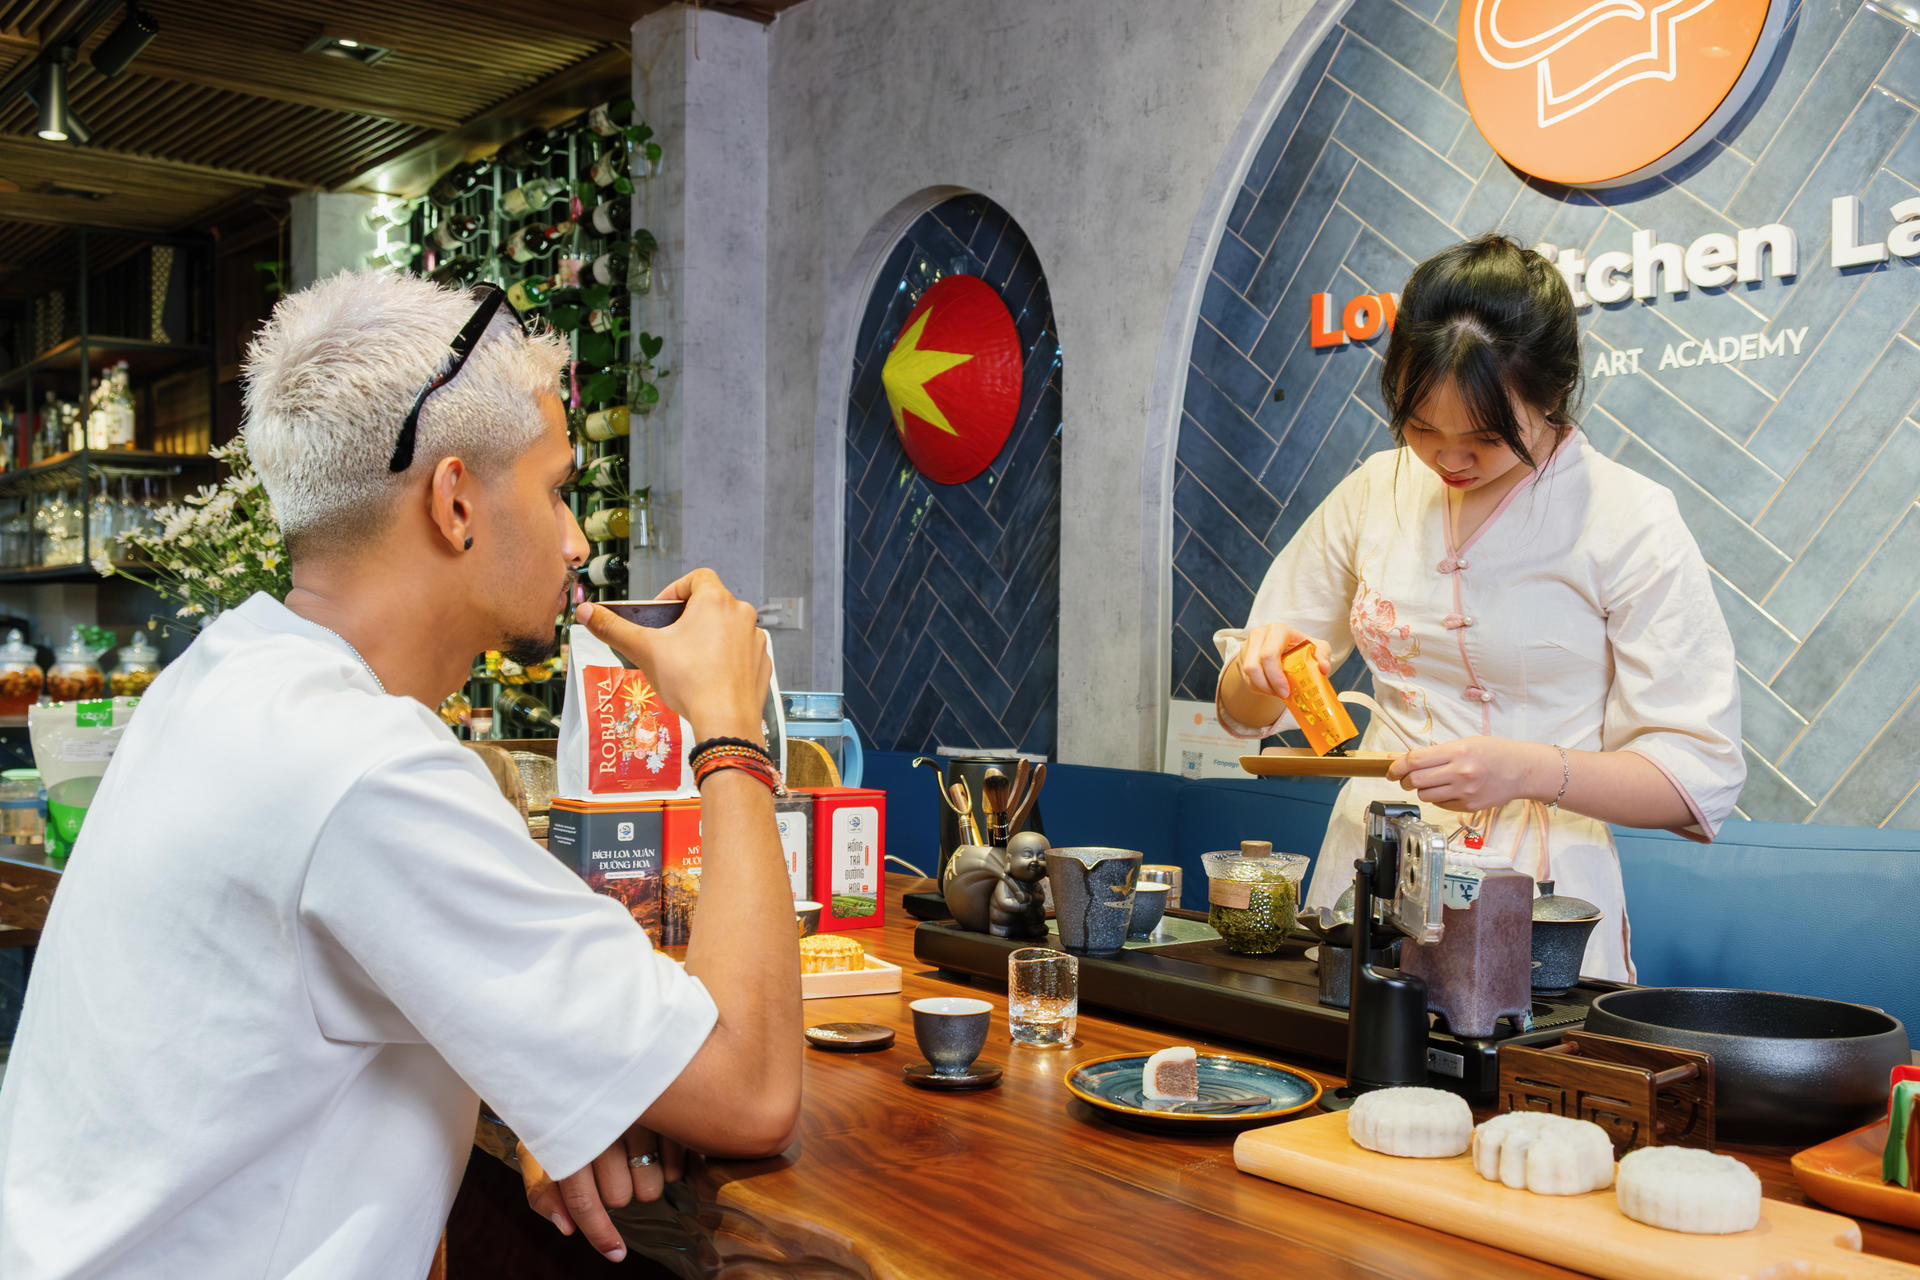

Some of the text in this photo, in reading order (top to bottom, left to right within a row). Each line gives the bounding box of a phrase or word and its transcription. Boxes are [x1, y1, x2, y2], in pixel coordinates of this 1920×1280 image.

[1591, 326, 1809, 379] ART ACADEMY
[597, 679, 616, 773] ROBUSTA
[613, 849, 630, 859] LOA
[632, 859, 651, 869] HOA
